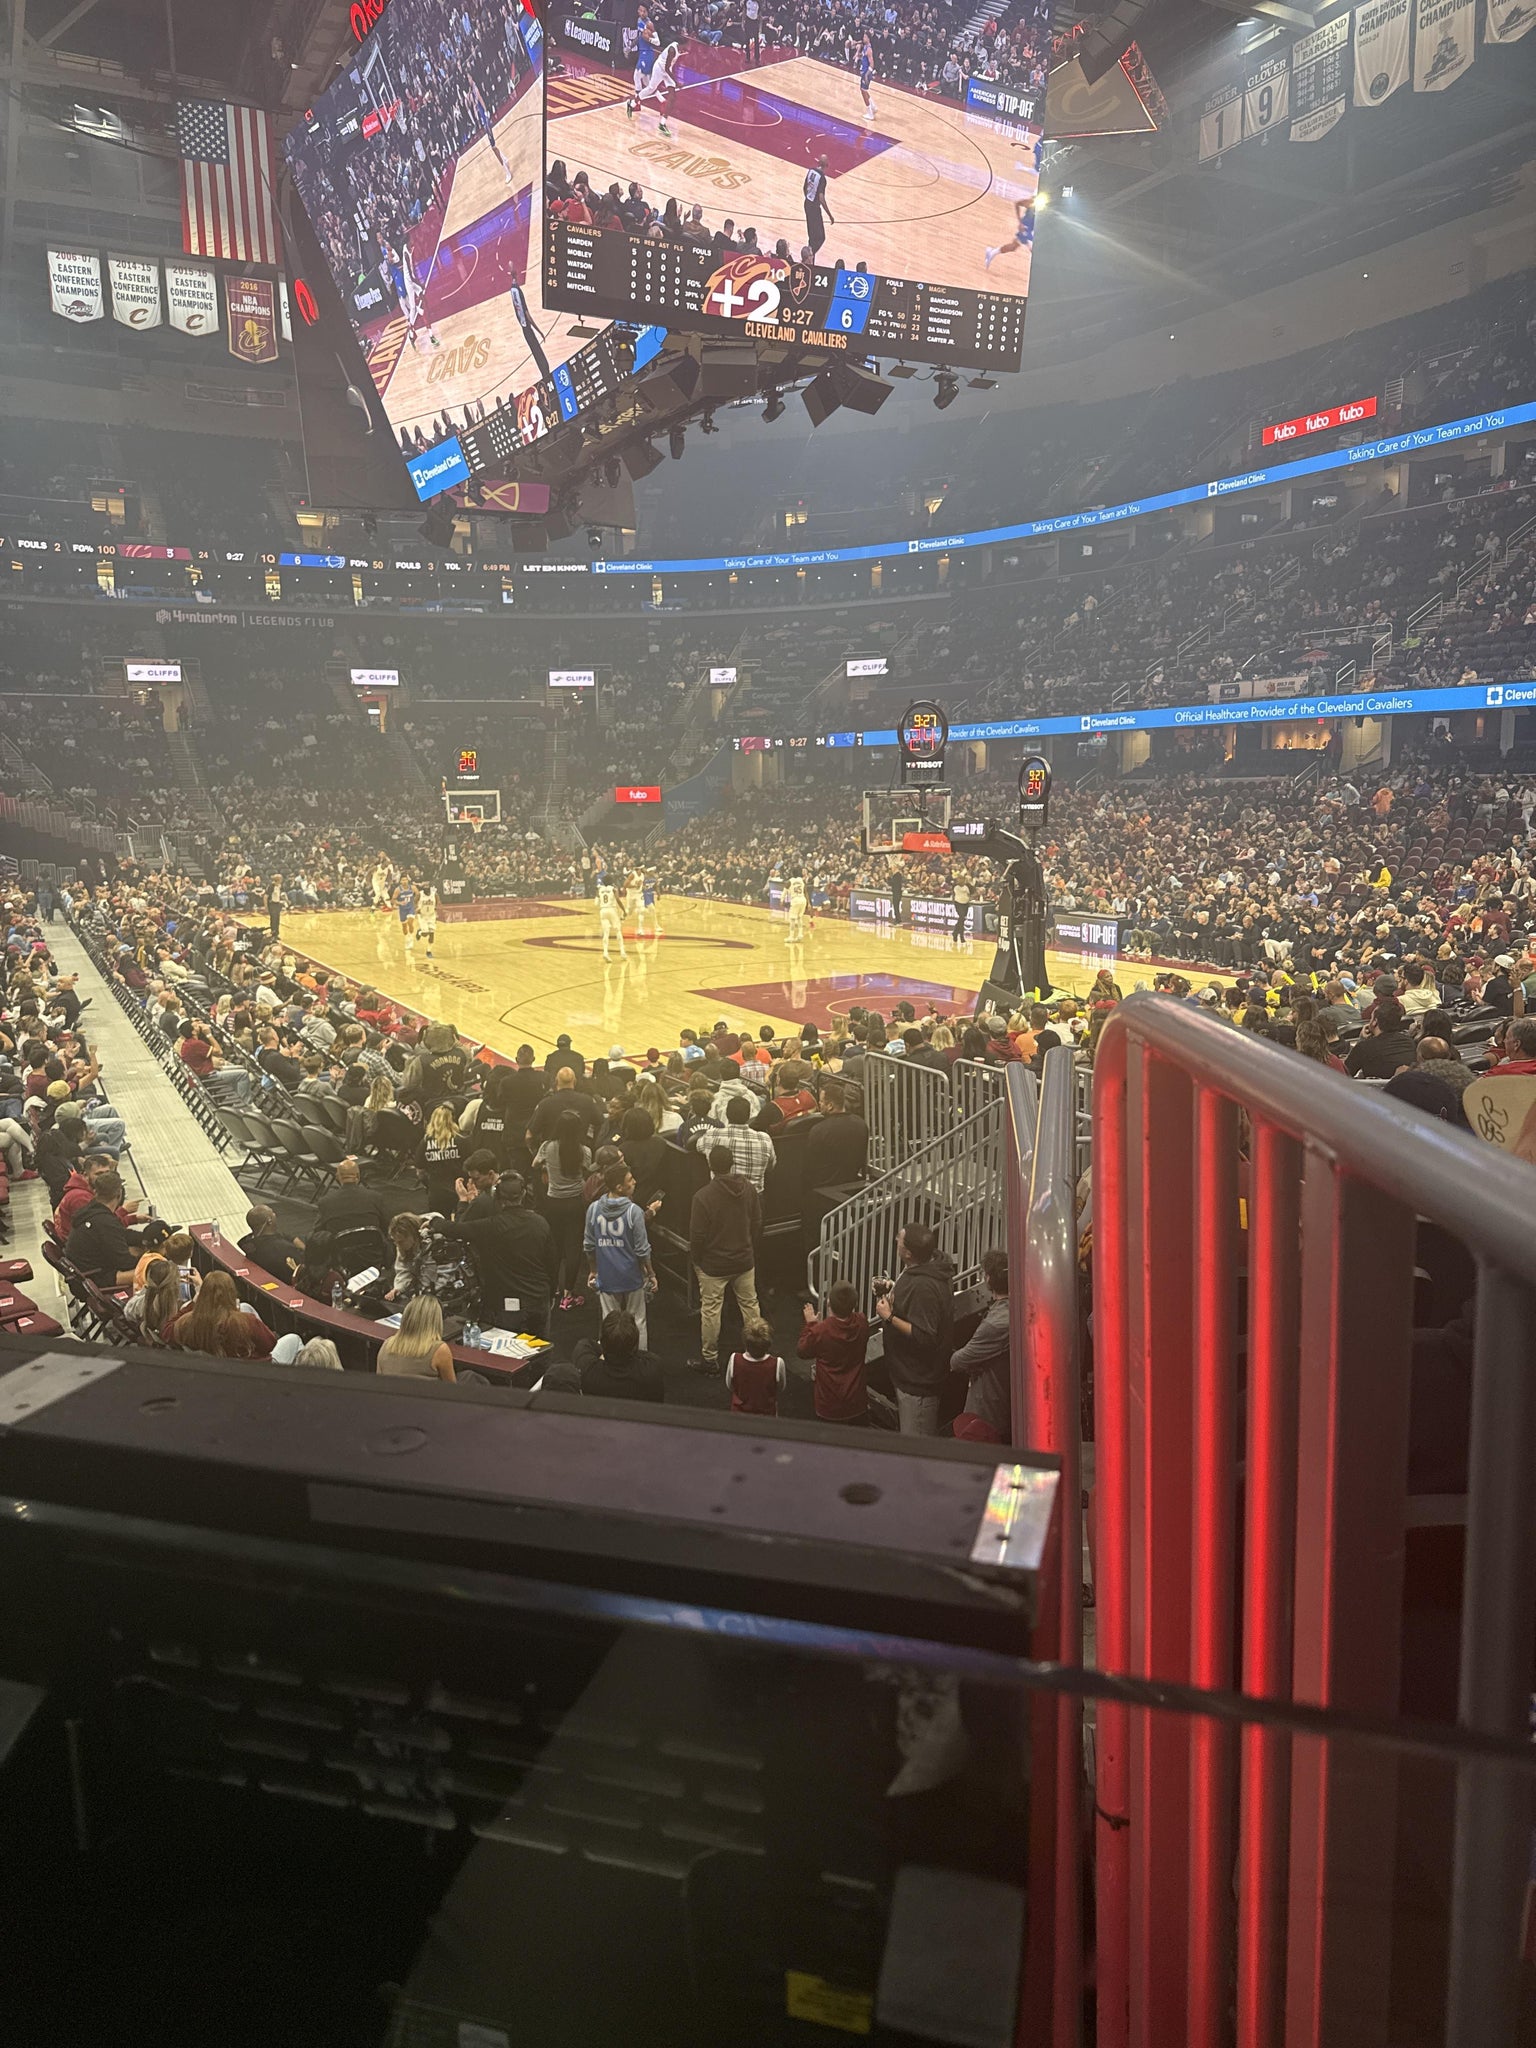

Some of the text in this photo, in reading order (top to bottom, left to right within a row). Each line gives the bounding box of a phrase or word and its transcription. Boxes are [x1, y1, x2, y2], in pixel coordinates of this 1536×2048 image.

[1359, 2, 1407, 36] CHAMPIONS
[571, 22, 594, 45] League
[594, 31, 610, 51] Pass
[1295, 18, 1347, 53] CLEVELAND
[1302, 34, 1337, 60] BARONS
[1248, 59, 1287, 87] GLOVER
[970, 88, 996, 99] AMERICAN
[973, 94, 996, 105] EXPRESS
[1206, 87, 1237, 111] BOWER
[1005, 94, 1034, 119] TIP-OFF
[1259, 85, 1273, 125] 9
[1215, 110, 1224, 150] 1
[628, 141, 752, 189] CAVS
[567, 225, 602, 237] CAVALIERS
[567, 237, 593, 247] HARDEN
[56, 251, 92, 263] 2006-07
[567, 249, 592, 258] MOBLEY
[693, 247, 711, 256] FOULS
[116, 260, 152, 271] 2014-15
[567, 260, 593, 270] WATSON
[699, 256, 705, 265] 2
[58, 264, 92, 275] EASTERN
[173, 266, 208, 277] 2015-16
[548, 268, 586, 280] 31 ALLEN
[771, 268, 785, 281] 1Q
[53, 274, 99, 287] CONFERENCE
[119, 272, 150, 283] EASTERN
[176, 278, 207, 289] EASTERN
[815, 275, 828, 287] 24
[886, 279, 903, 287] FOULS
[114, 282, 158, 294] CONFERENCE
[241, 282, 258, 291] 2016
[567, 282, 596, 293] MITCHELL
[687, 280, 701, 288] FG%
[929, 286, 946, 294] MAGIC
[56, 285, 98, 297] CHAMPIONS
[170, 288, 214, 300] CONFERENCE
[116, 292, 156, 304] CHAMPIONS
[243, 295, 257, 305] NBA
[712, 278, 781, 324] +2
[930, 297, 959, 306] BANCHERO
[173, 299, 213, 311] CHAMPIONS
[231, 303, 271, 316] CHAMPIONS
[686, 302, 698, 310] TOL
[782, 308, 814, 325] 9:27
[929, 307, 963, 316] RICHARDSON
[841, 309, 852, 328] 6
[745, 322, 847, 349] CLEVELAND CAVALIERS
[869, 329, 880, 337] TOL
[927, 336, 947, 344] CARTER
[427, 335, 491, 384] CAVS
[565, 398, 572, 413] 6
[545, 410, 559, 428] 9:27
[1274, 406, 1364, 441] fubo fubo fubo
[1348, 414, 1504, 461] Taking Care of Your Team and You
[423, 460, 449, 480] Cleveland
[446, 454, 461, 468] Clinic
[1218, 474, 1265, 491] Cleveland Clinic
[1032, 505, 1140, 533] Taking Care of Your Team and You
[919, 537, 965, 550] Cleveland Clinic
[18, 540, 47, 549] FOULS
[54, 543, 61, 551] 2
[73, 545, 94, 553] FG%
[98, 546, 115, 554] 100
[199, 551, 208, 559] 24
[226, 553, 244, 561] 9:27
[261, 554, 276, 563] 1Q
[373, 561, 383, 569] 50
[396, 562, 421, 570] FOULS
[445, 562, 460, 571] TOL
[483, 563, 498, 571] 6:49
[724, 553, 838, 568] Taking Care of Your Team and You
[606, 562, 653, 571] Cleveland Clinic
[173, 610, 300, 627] Huntington LEGENDS
[1505, 689, 1536, 700] Clevel
[1175, 697, 1413, 723] Official Healthcare Provider of the Cleveland Cavaliers
[914, 714, 936, 727] 9:27
[1091, 716, 1136, 727] Cleveland Clinic
[948, 724, 1039, 738] Provider the Cleveland Cavaliers
[789, 738, 807, 747] 9:27
[909, 728, 934, 751] 24
[459, 759, 476, 771] 24
[1029, 770, 1044, 780] 9:27
[1028, 782, 1041, 795] 24
[1060, 930, 1080, 938] EXPRESS
[1088, 924, 1116, 946] TIP-OFF
[431, 1056, 460, 1070] MOONDOG
[427, 1138, 457, 1150] ANAL
[425, 1149, 460, 1161] CONTROL
[597, 1215, 624, 1236] 10
